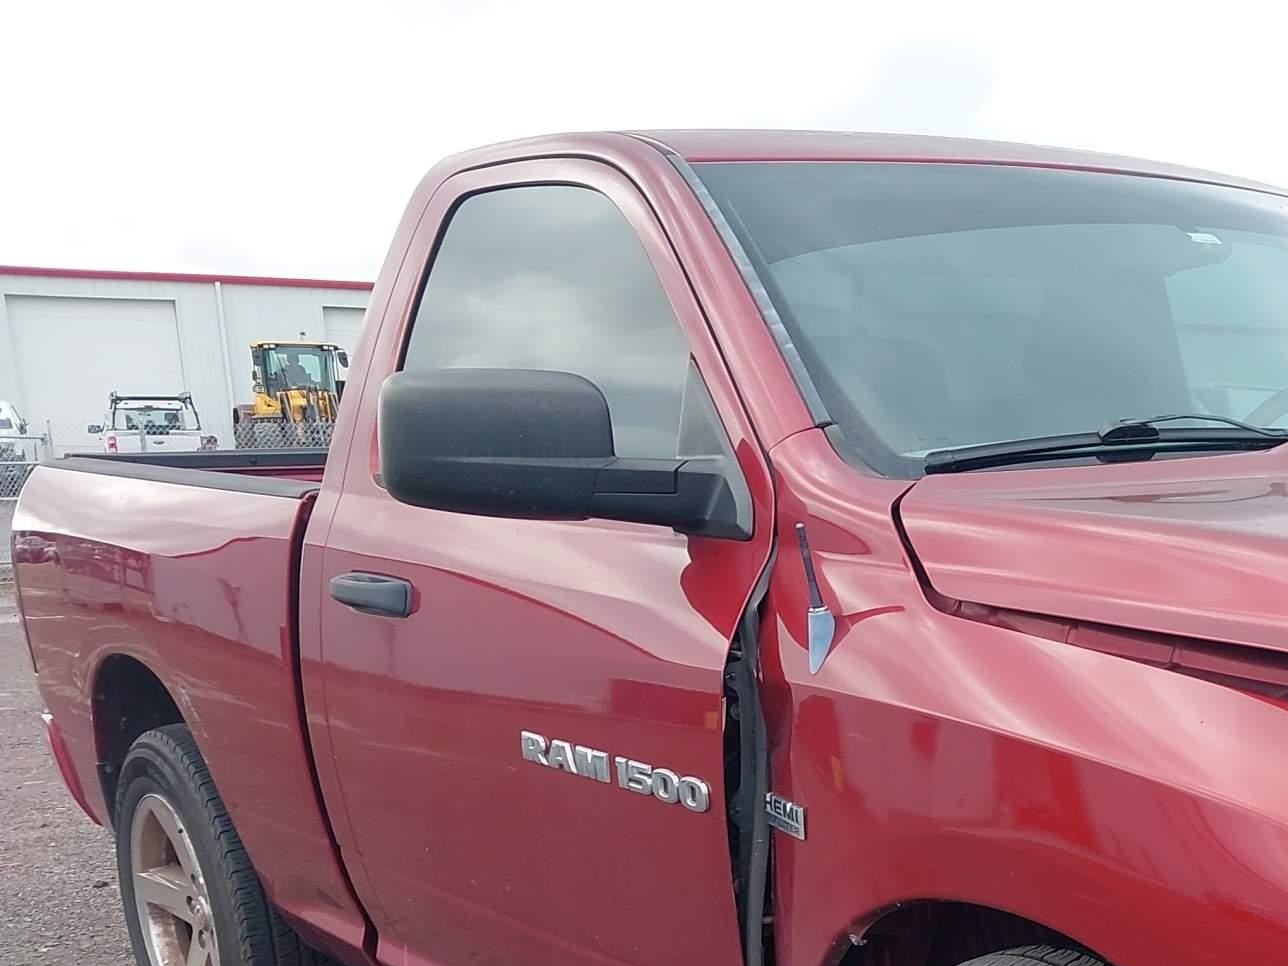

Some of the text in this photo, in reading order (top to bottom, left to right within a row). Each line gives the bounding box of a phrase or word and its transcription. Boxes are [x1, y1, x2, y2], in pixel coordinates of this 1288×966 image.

[521, 731, 711, 813] RAM 1500
[763, 790, 800, 823] HEMI
